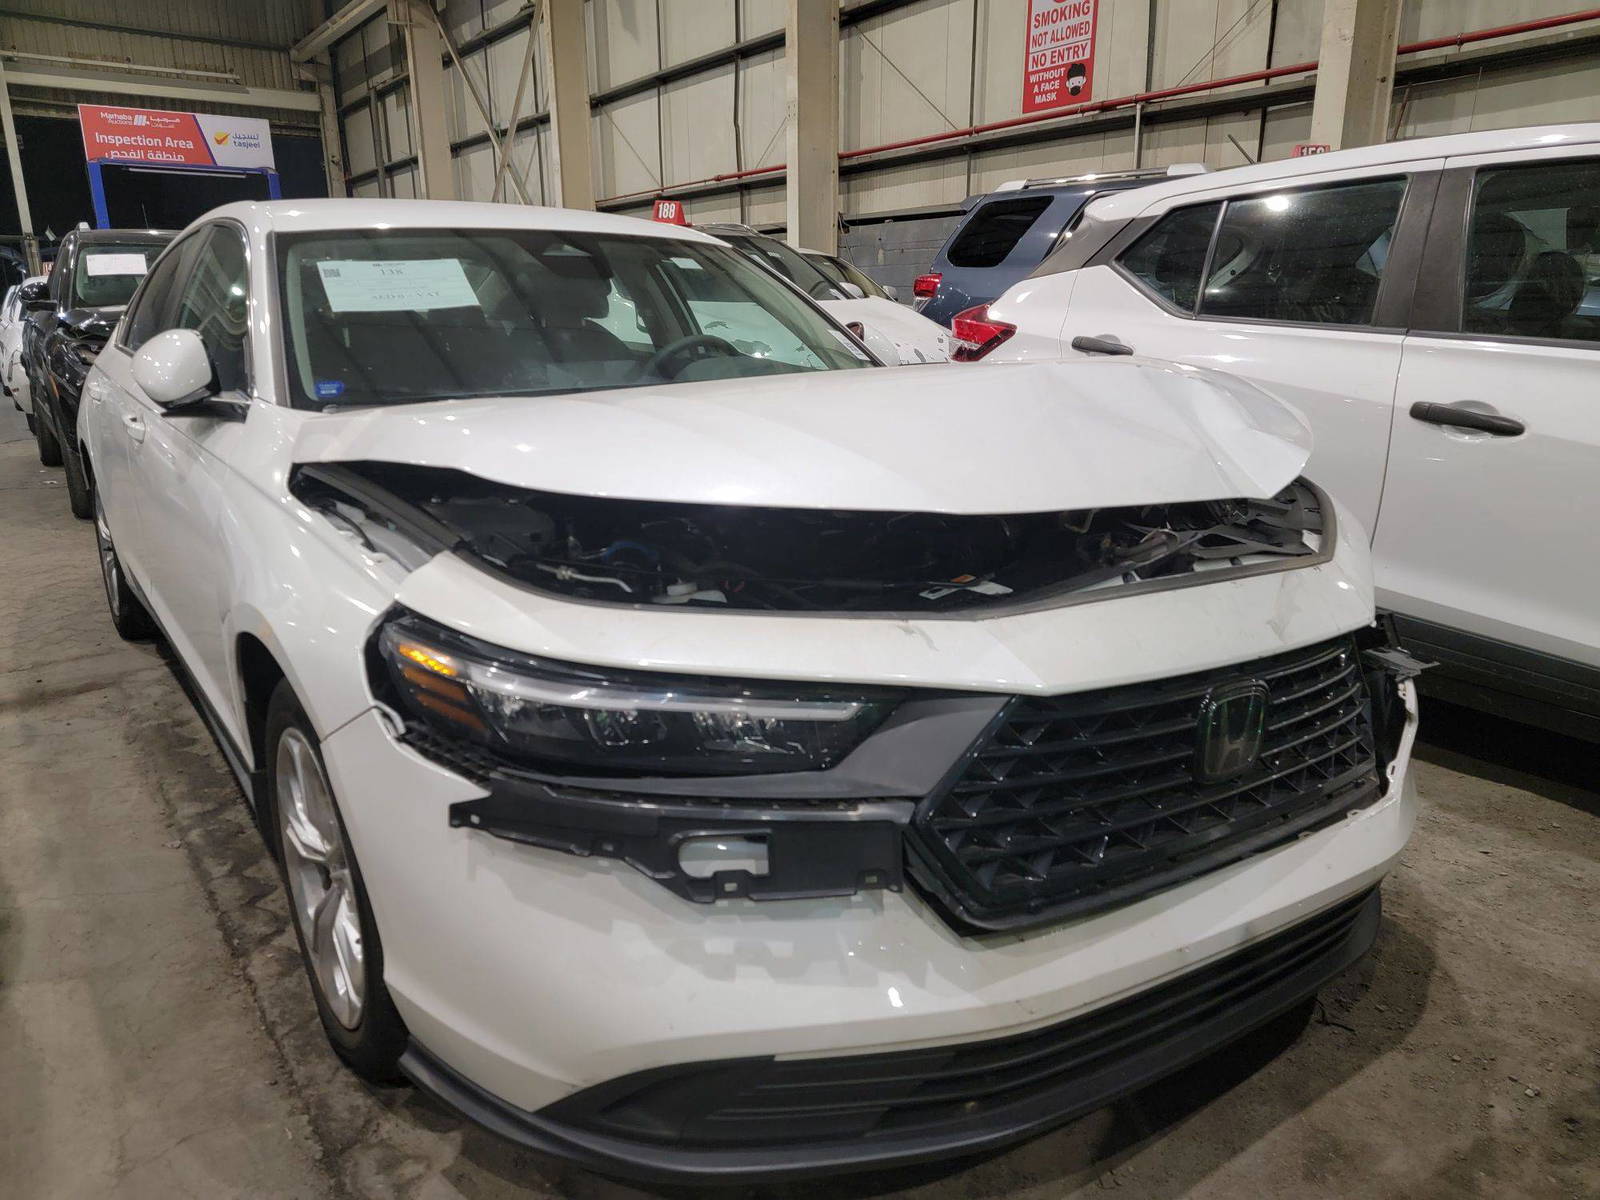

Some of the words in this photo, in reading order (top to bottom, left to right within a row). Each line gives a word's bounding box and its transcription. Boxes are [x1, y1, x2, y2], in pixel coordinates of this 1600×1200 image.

[1034, 1, 1090, 28] SMOKING
[1032, 31, 1049, 48] NOT
[1050, 21, 1090, 43] ALLOWED
[1032, 53, 1047, 69] NO
[1050, 43, 1088, 64] ENTRY
[1030, 68, 1066, 83] WITHOUT
[1033, 84, 1039, 93] A
[1041, 80, 1060, 91] FACE
[1035, 92, 1057, 104] MASK
[100, 112, 132, 121] Marhaba
[95, 132, 162, 147] Inspection
[165, 137, 194, 149] Area
[233, 140, 261, 149] tasjeel
